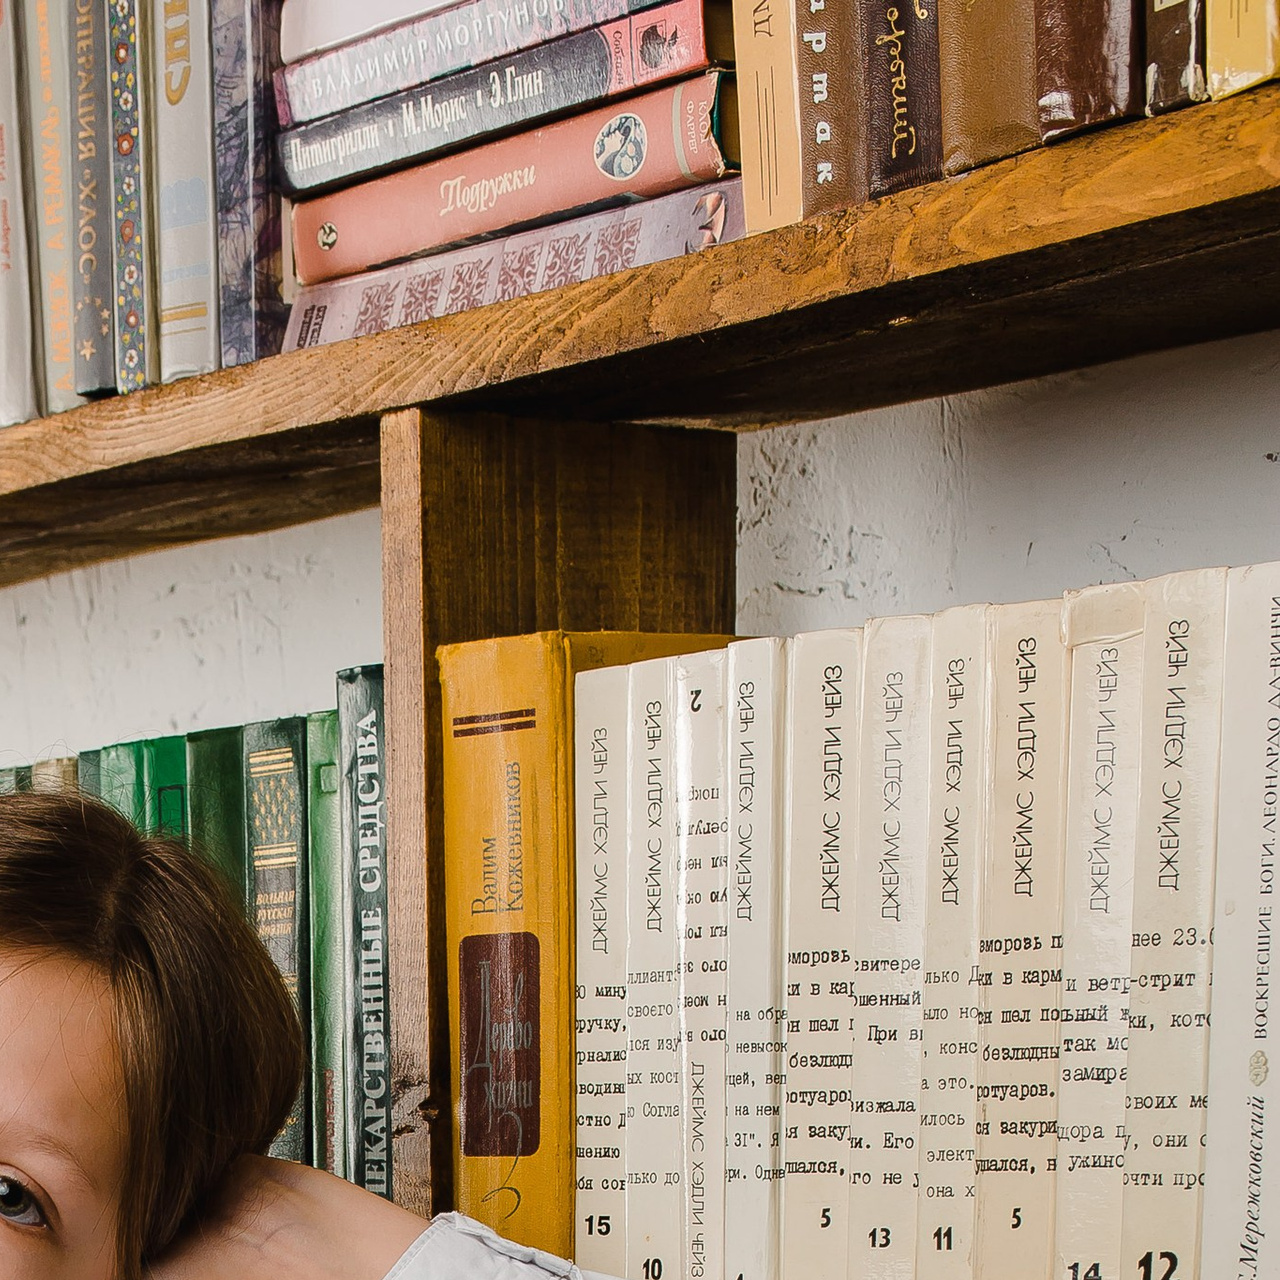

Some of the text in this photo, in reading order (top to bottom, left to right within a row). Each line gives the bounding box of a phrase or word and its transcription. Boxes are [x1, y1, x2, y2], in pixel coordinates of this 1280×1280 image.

[312, 43, 429, 97] ВЛАДИМИР
[290, 67, 544, 173] Питигрилли М.Морис Э.Глин
[685, 101, 699, 155] ФАРРЕР
[439, 163, 537, 216] Подружки
[77, 168, 98, 284] «ХАОС»
[690, 689, 702, 712] 2
[940, 658, 965, 905] ДЖЕЙМС ХЭДЛИ ЧЕЙЗ
[1012, 637, 1037, 897] ДЖЕЙМС ХЭДЛИ ЧЕЙЗ
[1088, 647, 1119, 914] ДЖЕЙМС ХЭДЛИ ЧЕЙЗ
[1156, 619, 1190, 892] ДЖЕЙМС ХЭДЛИ ЧЕЙЗ
[1262, 718, 1280, 832] ЛЕОНАРДО
[356, 710, 384, 893] СРЕДСТВА
[735, 681, 755, 921] ДЖЕЙМС ХЭДЛИ ЧЕЙЗ
[820, 665, 843, 912] ДЖЕЙМС ХЭДЛИ ЧЕЙЗ
[878, 671, 903, 922] ДЖЕЙМС ХЭДЛИ ЧЕЙЗ
[497, 761, 524, 913] Кожевников
[590, 727, 608, 954] ДЖЕЙМС ХЭДЛИ ЧЕЙЗ
[644, 700, 663, 932] ДЖЕЙМС ХЭДЛИ ЧЕЙЗ
[471, 837, 499, 916] Вадим
[1253, 906, 1272, 1039] ВОСКРЕСШИЕ
[466, 962, 532, 1076] Дерево
[627, 1004, 673, 1020] своего
[809, 1018, 839, 1031] шел
[868, 1026, 897, 1044] При
[1001, 1007, 1031, 1023] шел
[983, 1044, 1060, 1061] безлюдны
[1063, 1036, 1096, 1053] так
[938, 1076, 975, 1090] это.
[883, 1133, 914, 1150] Его
[1153, 1133, 1188, 1148] они
[691, 1061, 706, 1278] ДЖЕЙМС ХЭДЛИ ЧЕЙЗ
[584, 1215, 611, 1236] 15
[820, 1207, 832, 1228] 5
[869, 1227, 892, 1248] 13
[933, 1226, 953, 1250] 11
[1011, 1207, 1022, 1229] 5
[642, 1258, 662, 1280] 10
